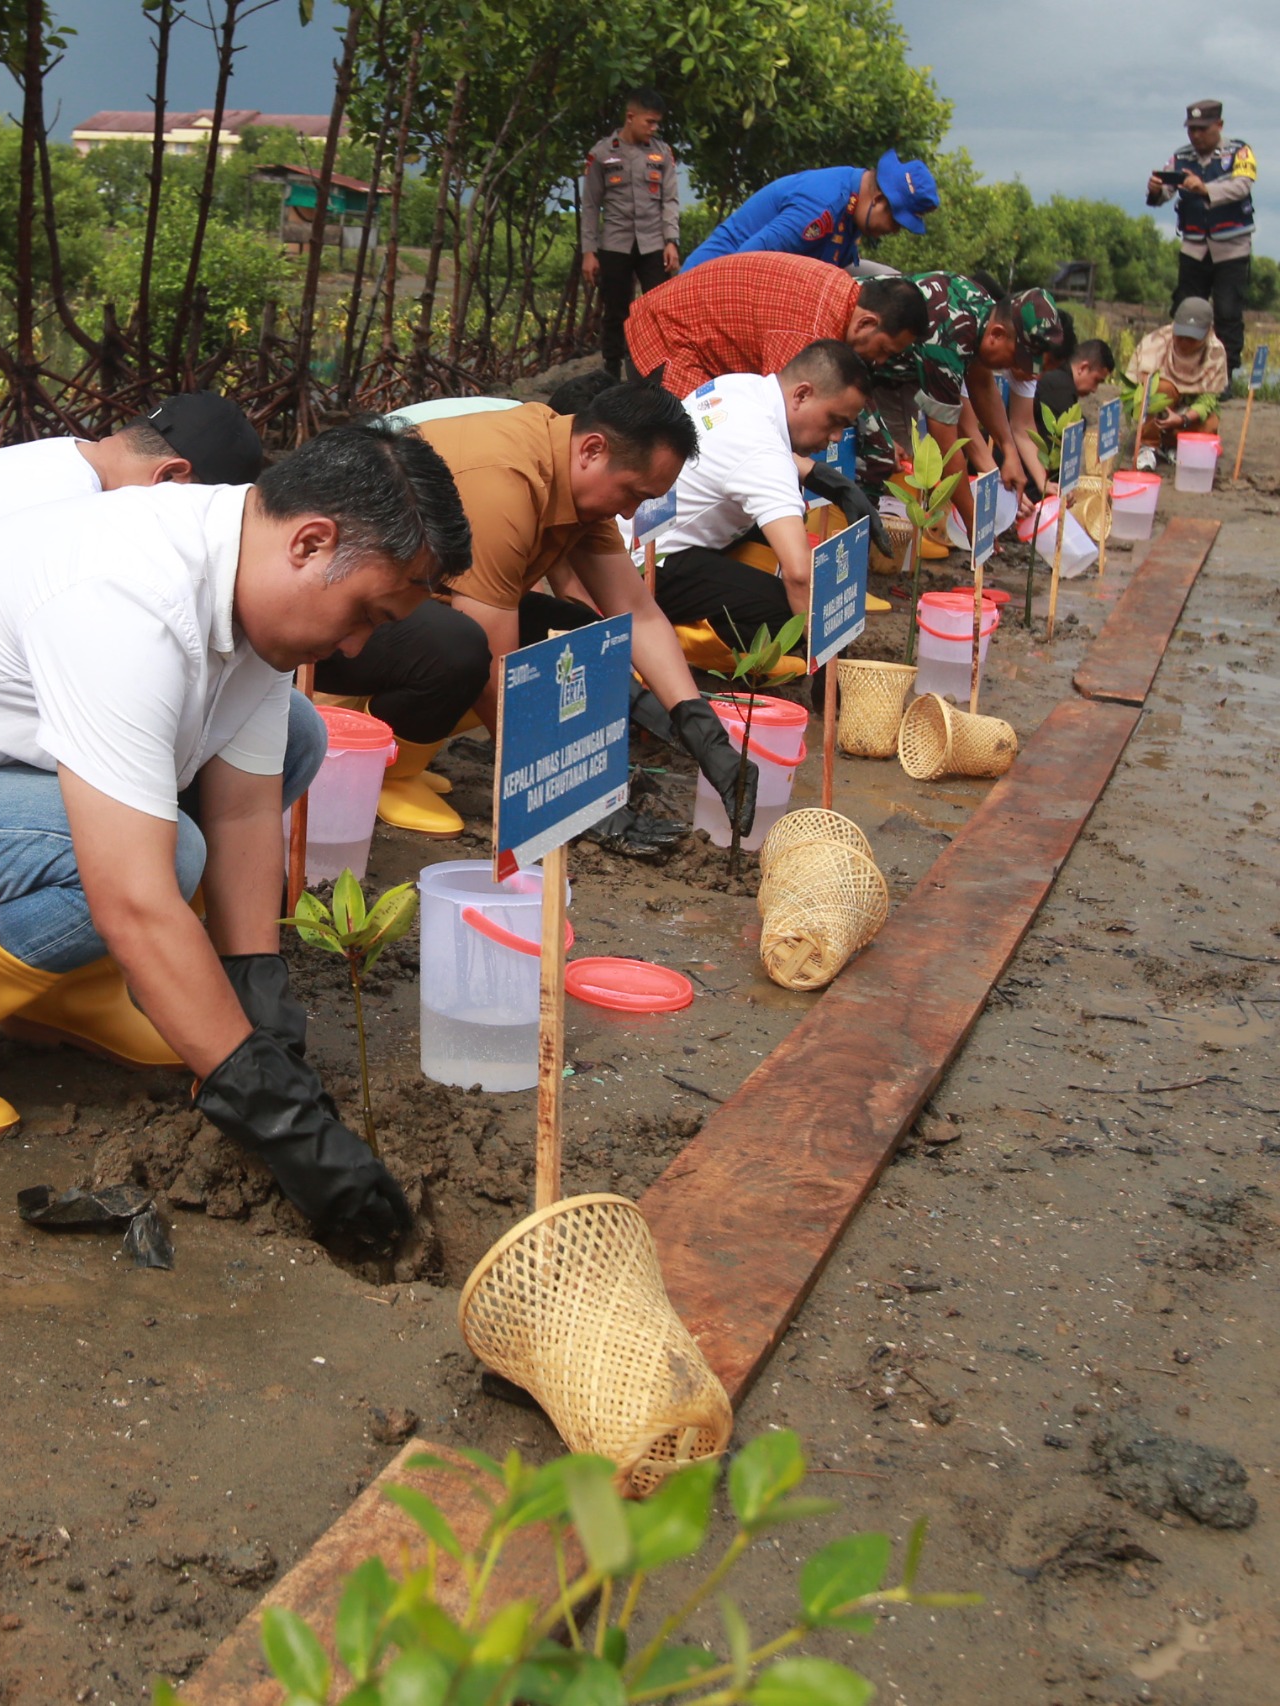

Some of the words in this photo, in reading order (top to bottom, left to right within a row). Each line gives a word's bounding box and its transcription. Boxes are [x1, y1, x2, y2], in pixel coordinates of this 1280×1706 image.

[502, 763, 535, 800] KEPALA
[536, 750, 560, 783] DINAS
[561, 727, 605, 770] LINGKUNGAN
[605, 717, 626, 746] HIDUP
[527, 784, 544, 813] DAN
[545, 760, 588, 803] KEHUTANAN
[589, 749, 608, 779] ACEH
